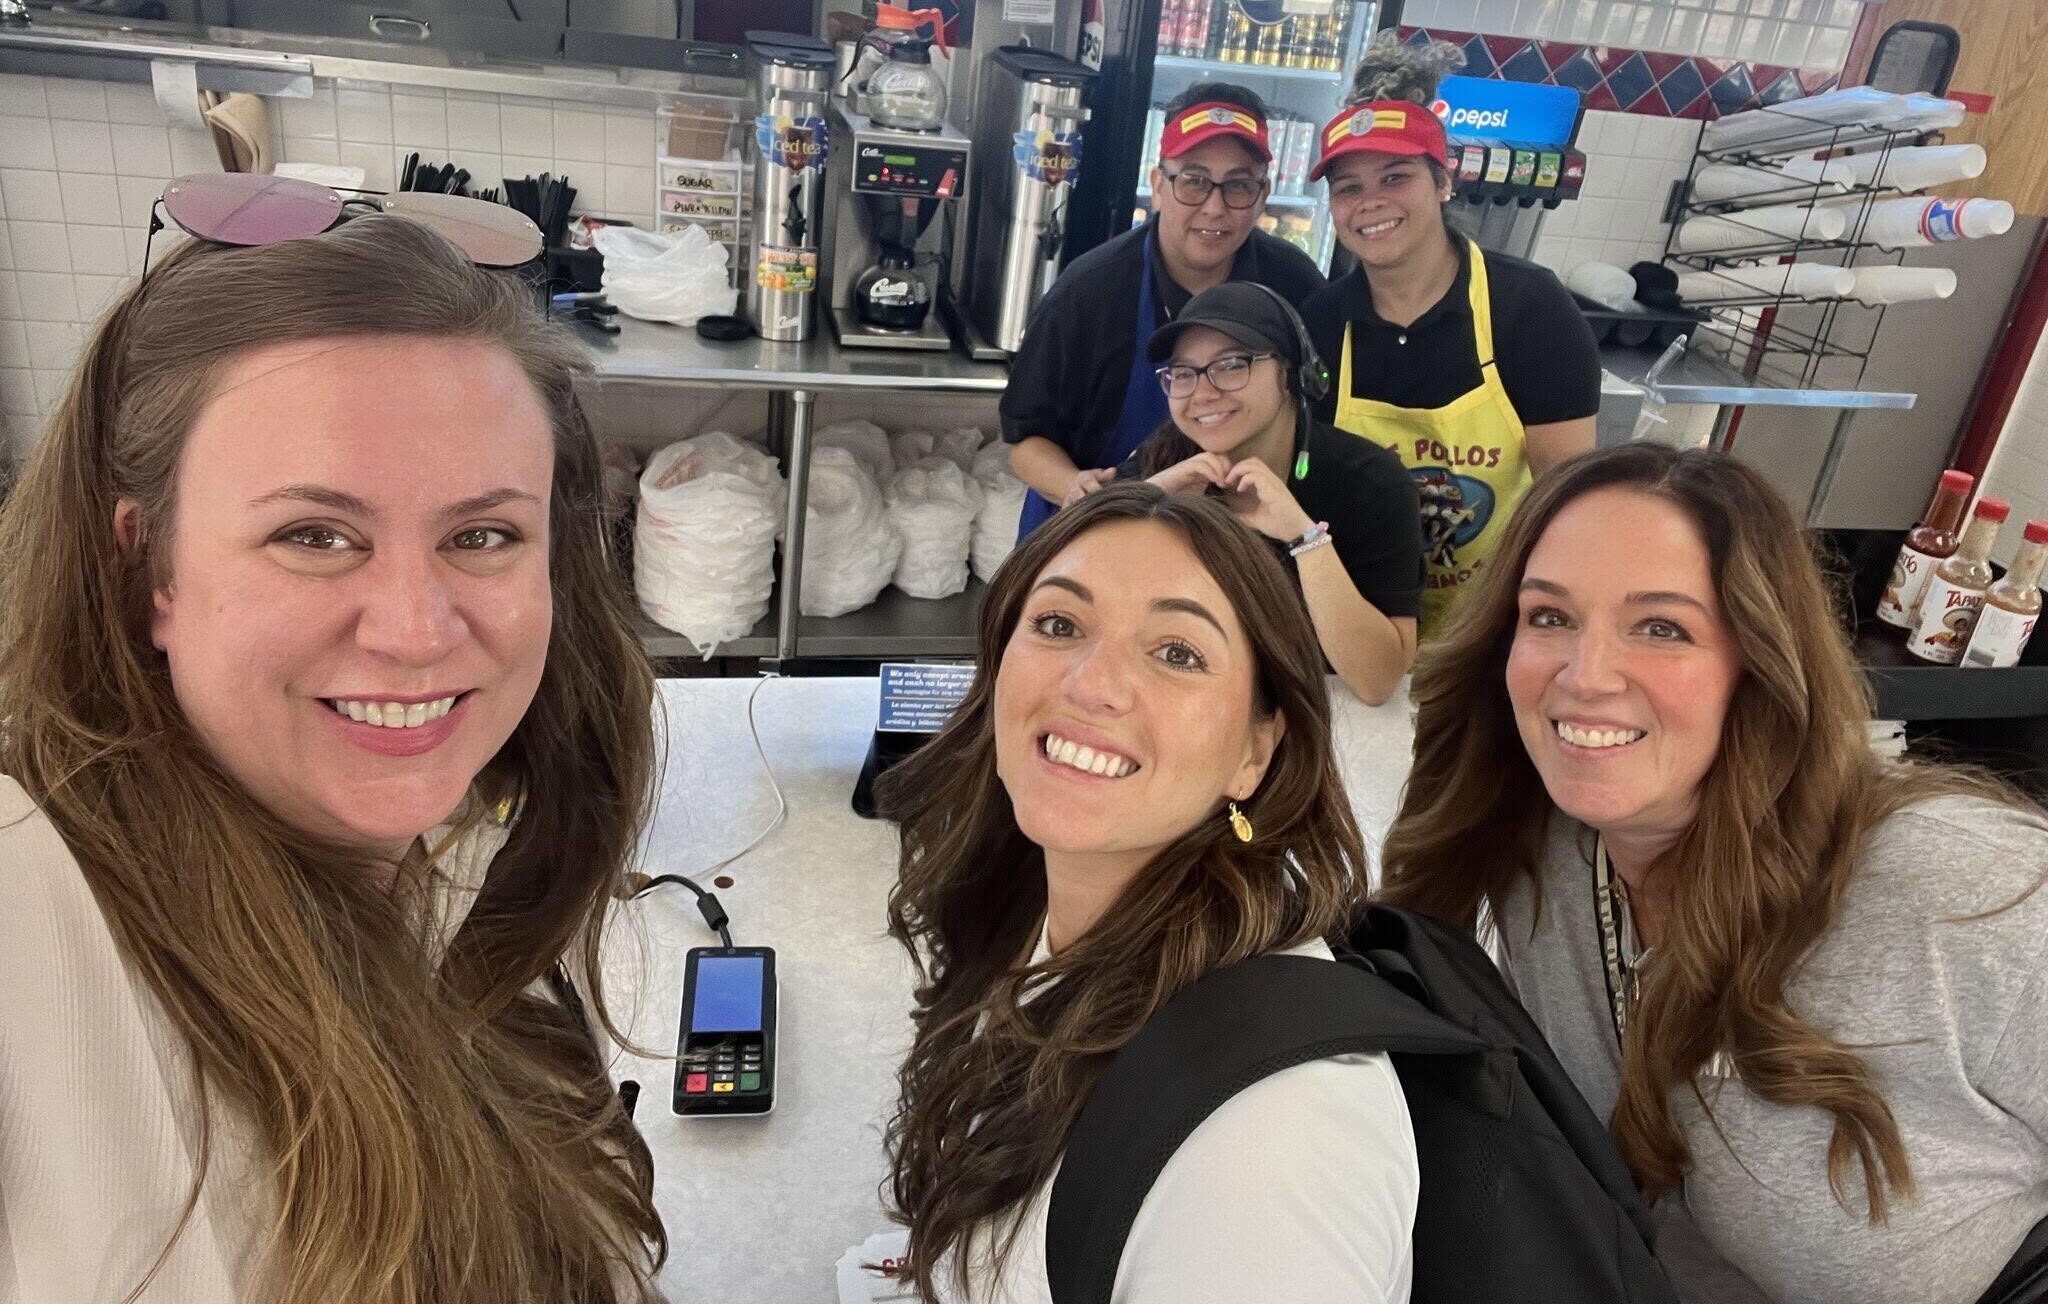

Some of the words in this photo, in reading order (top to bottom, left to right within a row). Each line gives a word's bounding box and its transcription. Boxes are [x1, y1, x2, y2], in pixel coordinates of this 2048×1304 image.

[1451, 108, 1508, 130] pepsi
[677, 175, 713, 189] SUGAR
[1415, 438, 1501, 468] POLLOS
[1945, 590, 1983, 609] TAPAT
[904, 671, 921, 680] only
